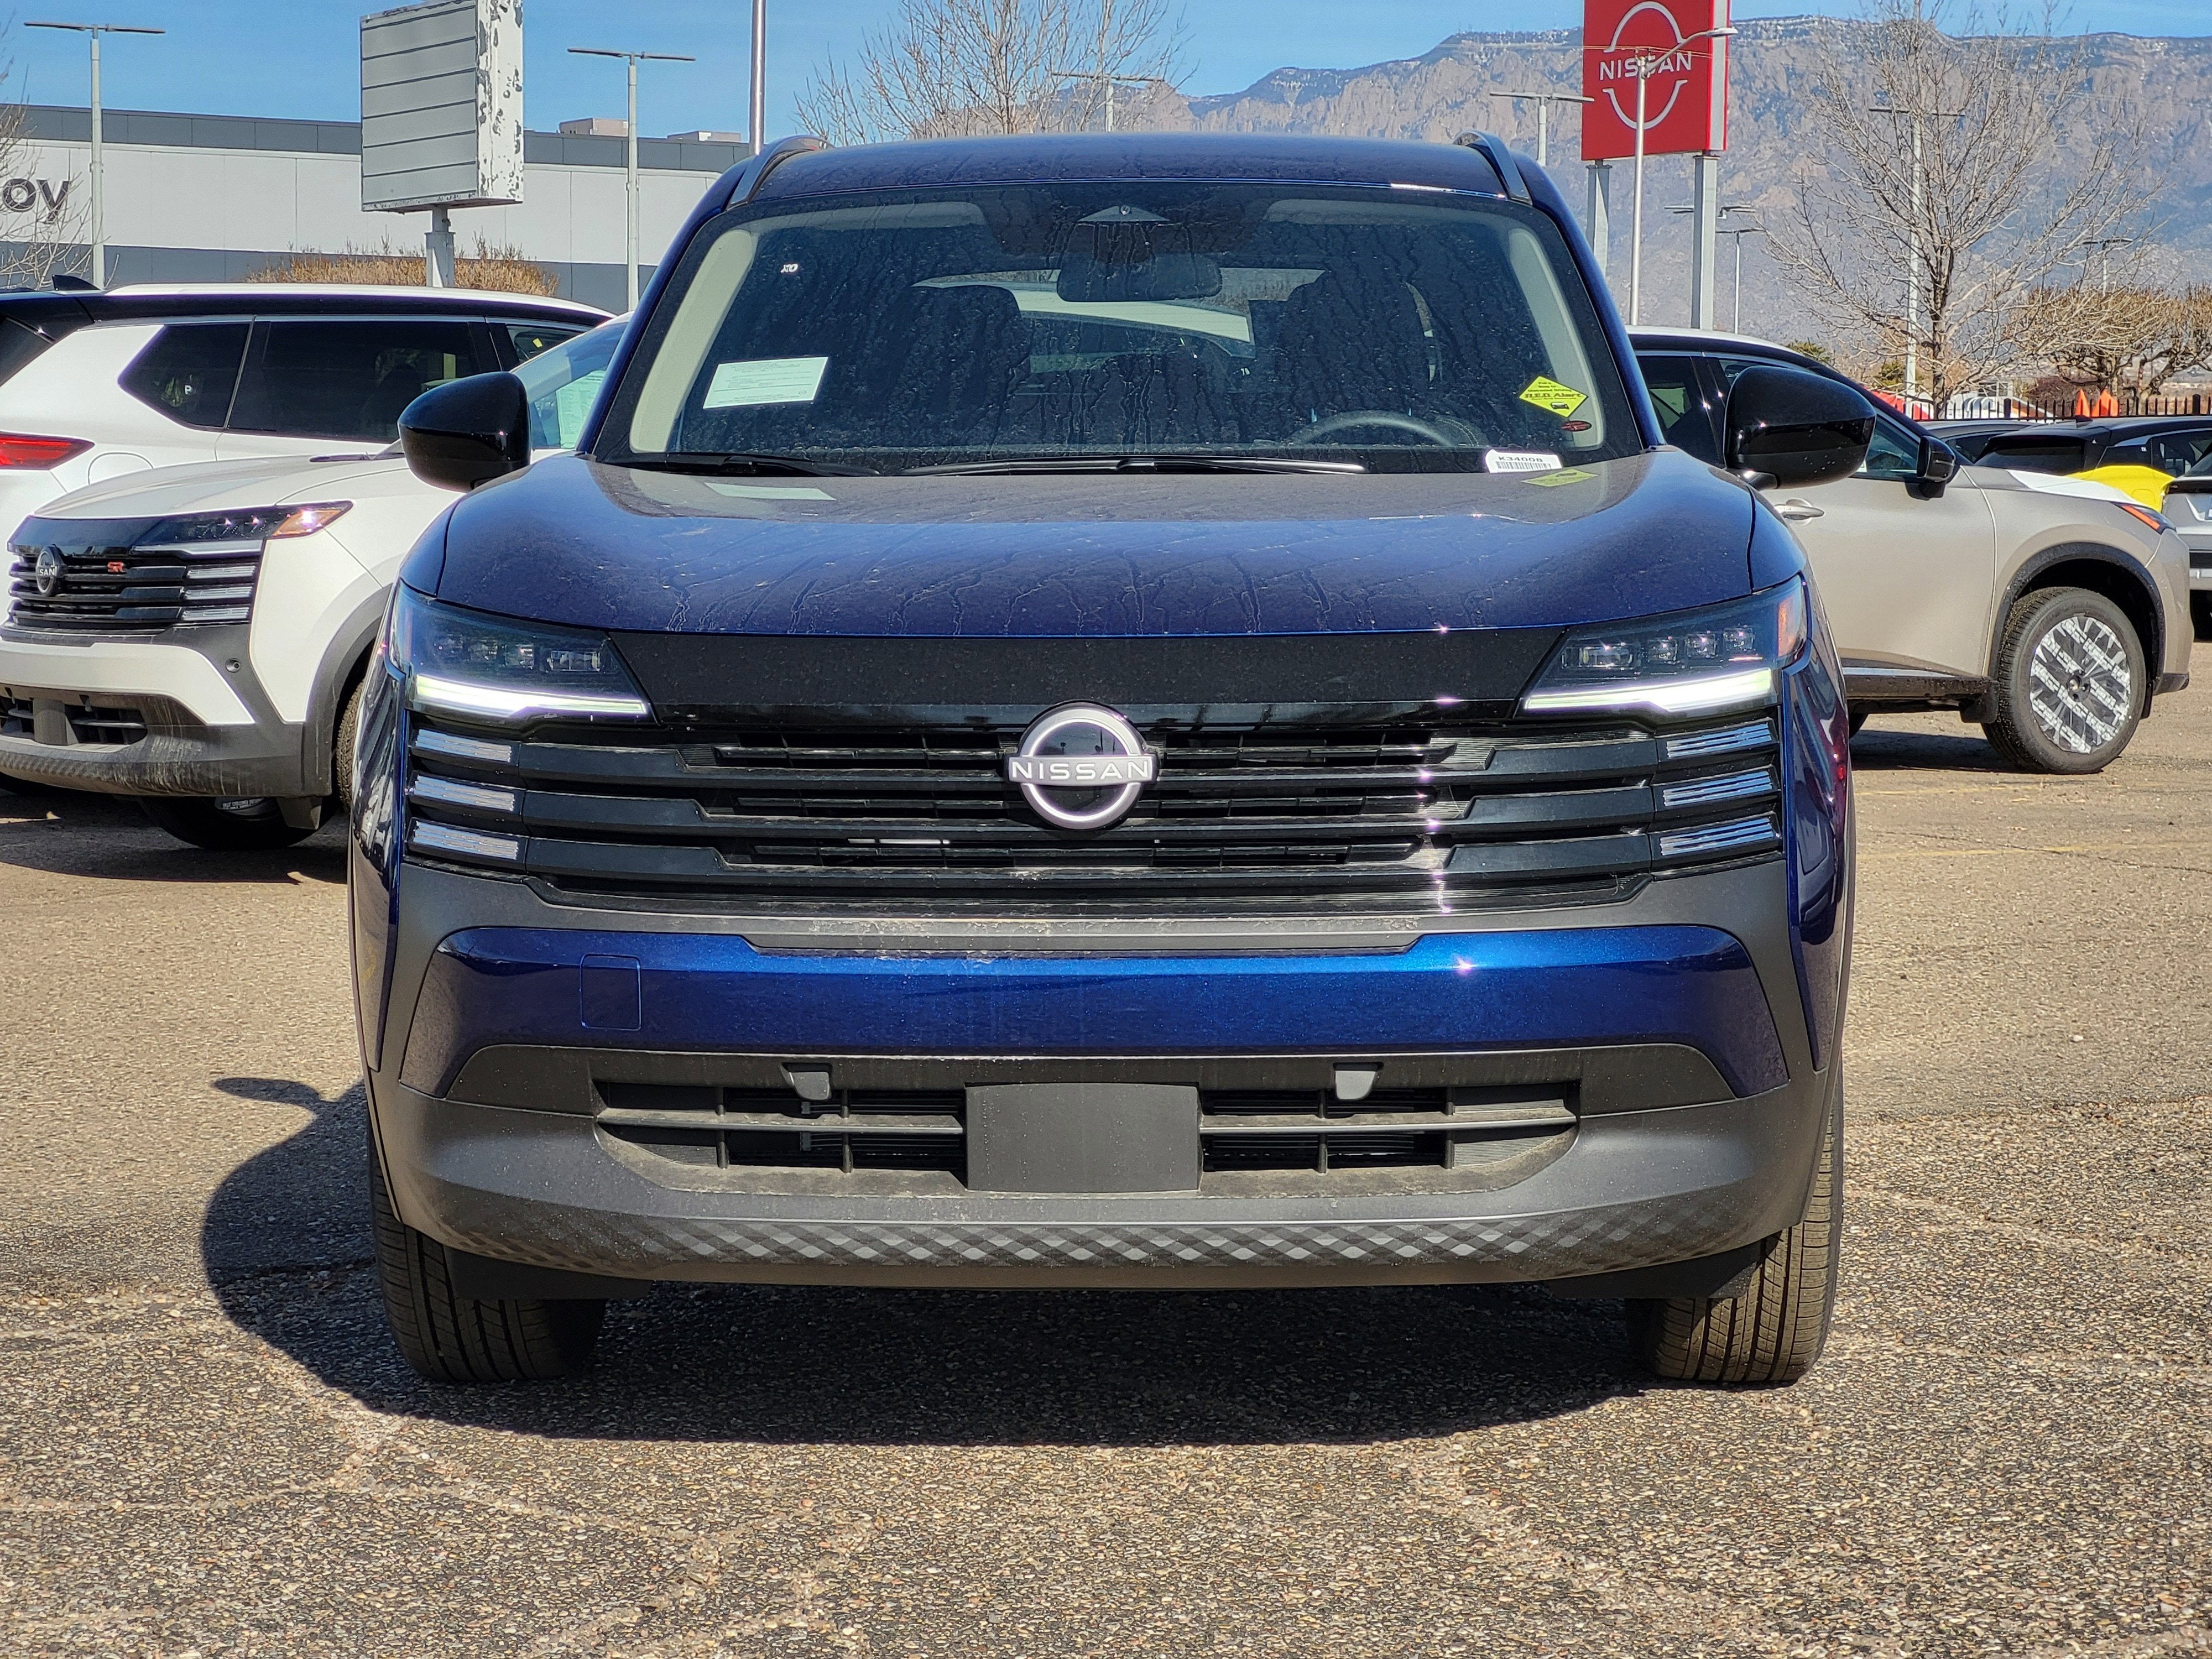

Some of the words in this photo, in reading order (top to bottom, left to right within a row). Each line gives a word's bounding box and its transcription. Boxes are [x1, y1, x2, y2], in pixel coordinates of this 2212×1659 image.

[3, 178, 70, 224] oy
[107, 561, 124, 572] SR
[1012, 760, 1149, 780] NISSAN
